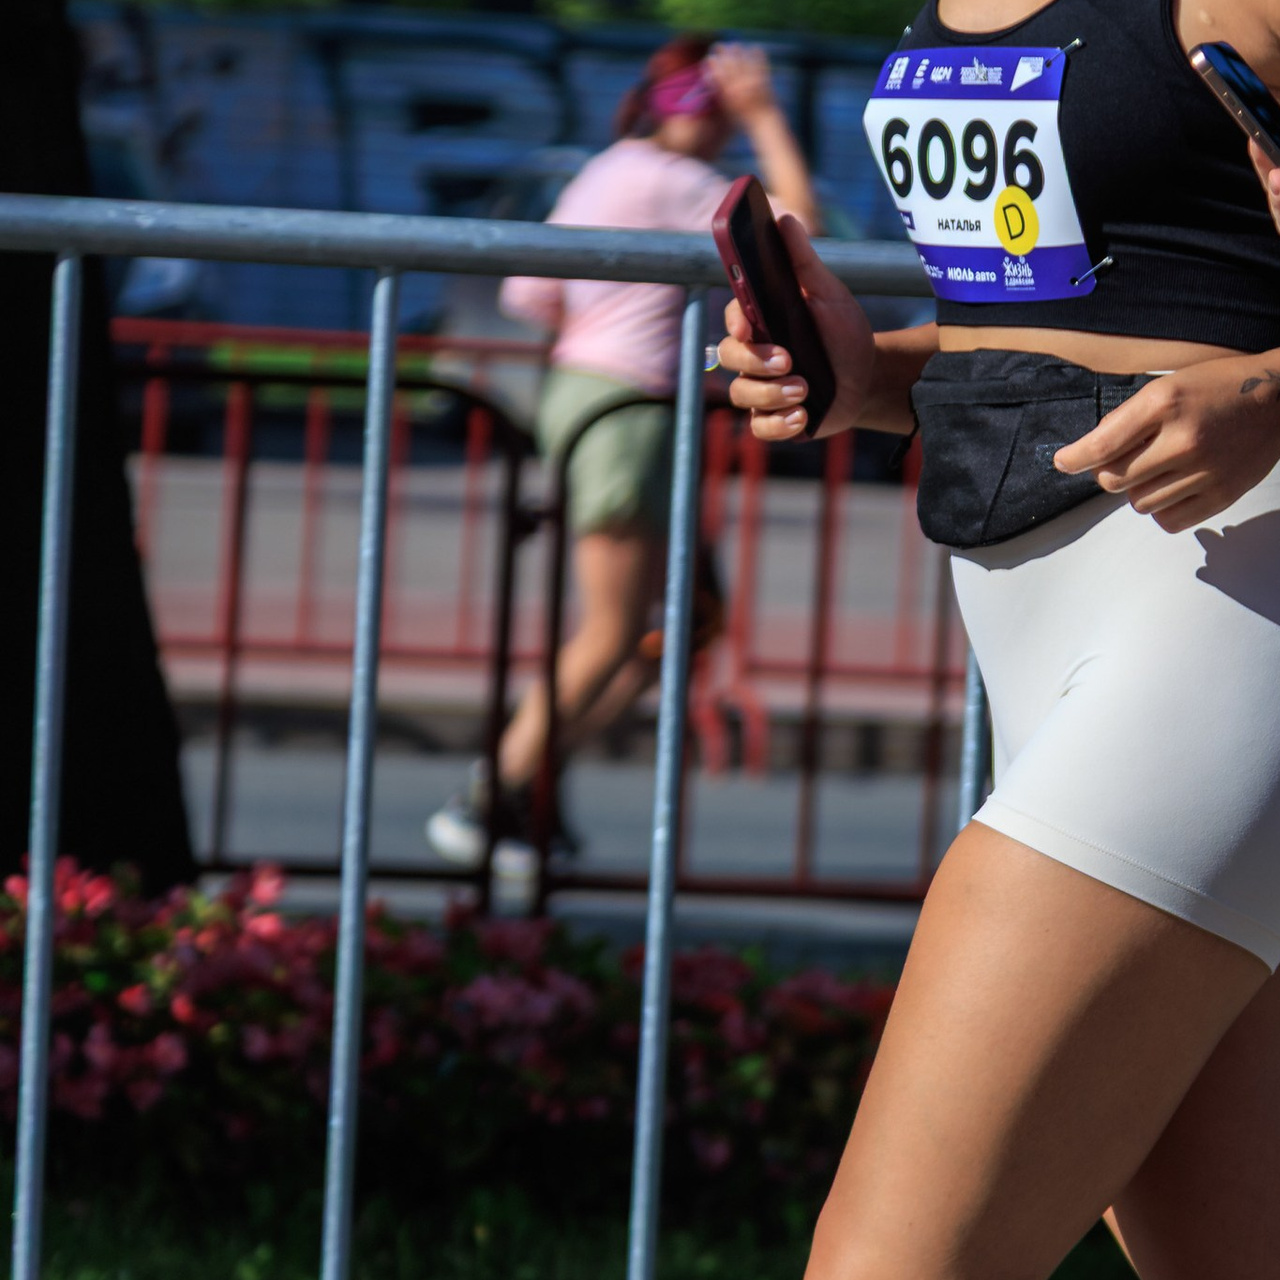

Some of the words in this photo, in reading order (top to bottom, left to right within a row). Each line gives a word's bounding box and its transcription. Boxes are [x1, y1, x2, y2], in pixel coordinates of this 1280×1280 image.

[882, 117, 1045, 202] 6096
[937, 219, 982, 231] НАТАЛЬЯ
[1002, 203, 1026, 241] D
[947, 266, 974, 282] ИЮЛЬ
[975, 271, 997, 283] авто
